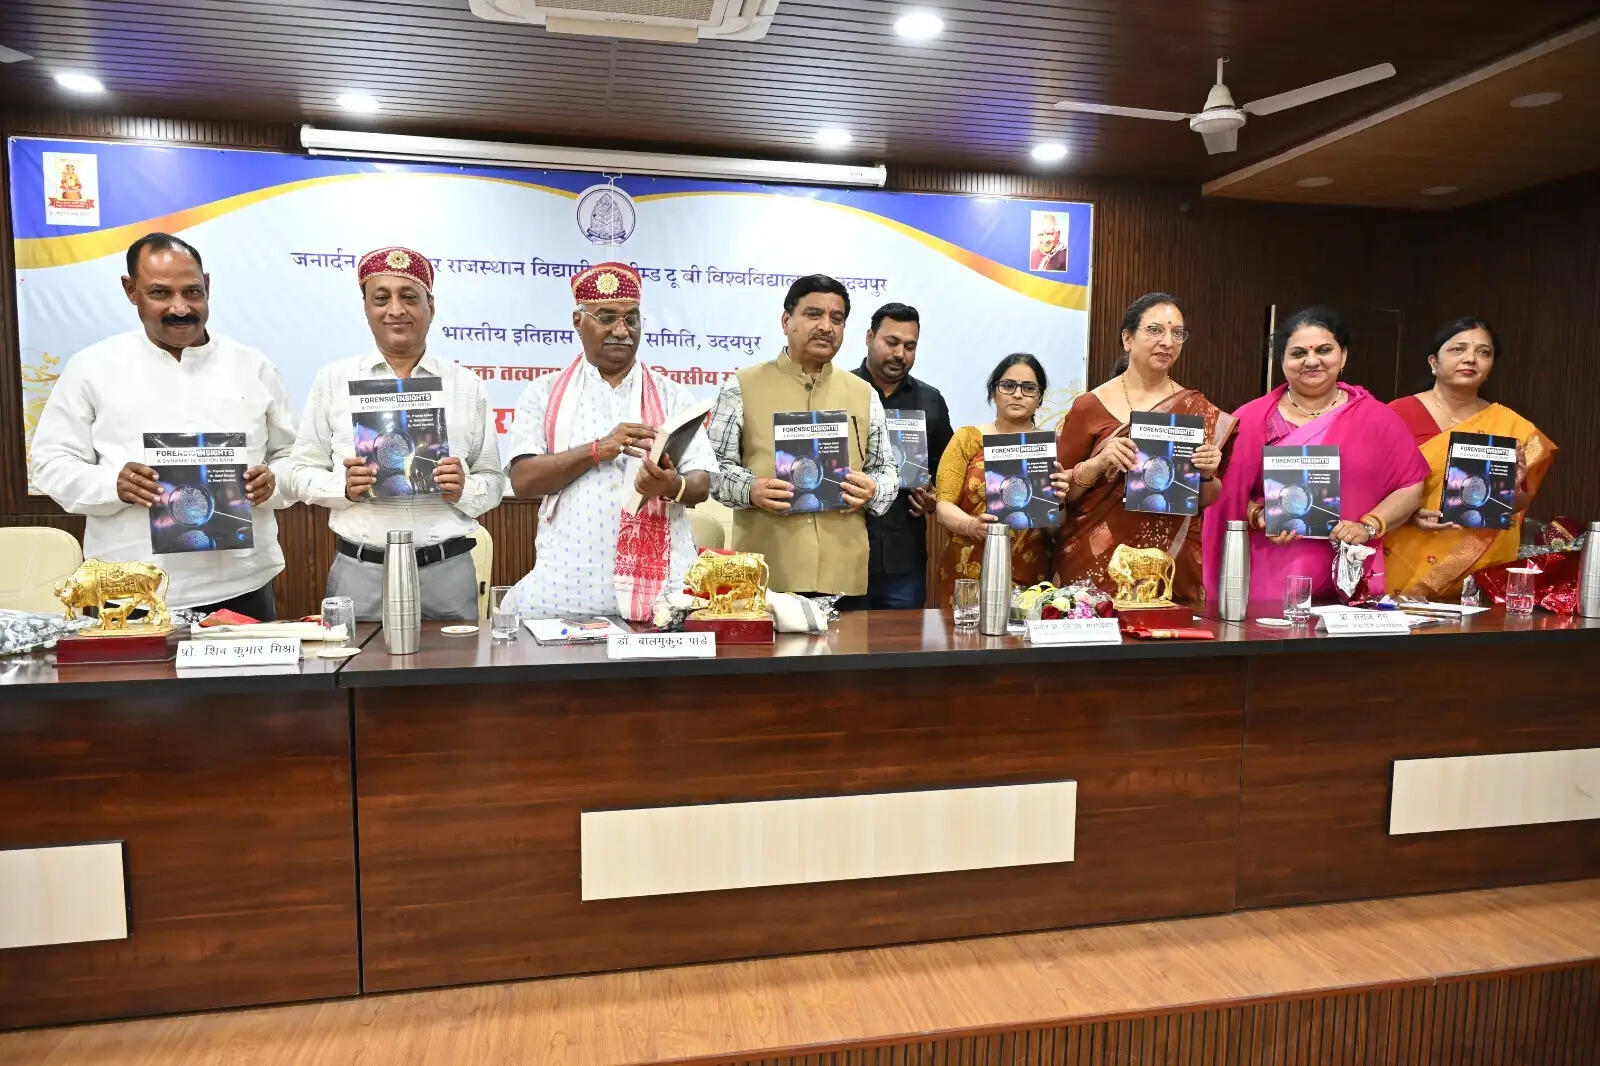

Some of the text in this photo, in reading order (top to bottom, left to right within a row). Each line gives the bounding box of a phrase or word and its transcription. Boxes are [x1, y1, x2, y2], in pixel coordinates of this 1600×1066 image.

[290, 247, 357, 272] जनार्दन
[447, 258, 526, 276] राजस्थान
[530, 256, 593, 278] विद्यापी
[664, 268, 681, 289] टू
[680, 264, 702, 284] बी
[441, 322, 762, 356] भारतीय इतिहास समिति, उदयपुर
[360, 392, 432, 404] FORENSIC INSIGHTS
[197, 448, 235, 458] INSIGHTS
[181, 642, 296, 658] प्रो. शिव कुमार मिश्रा
